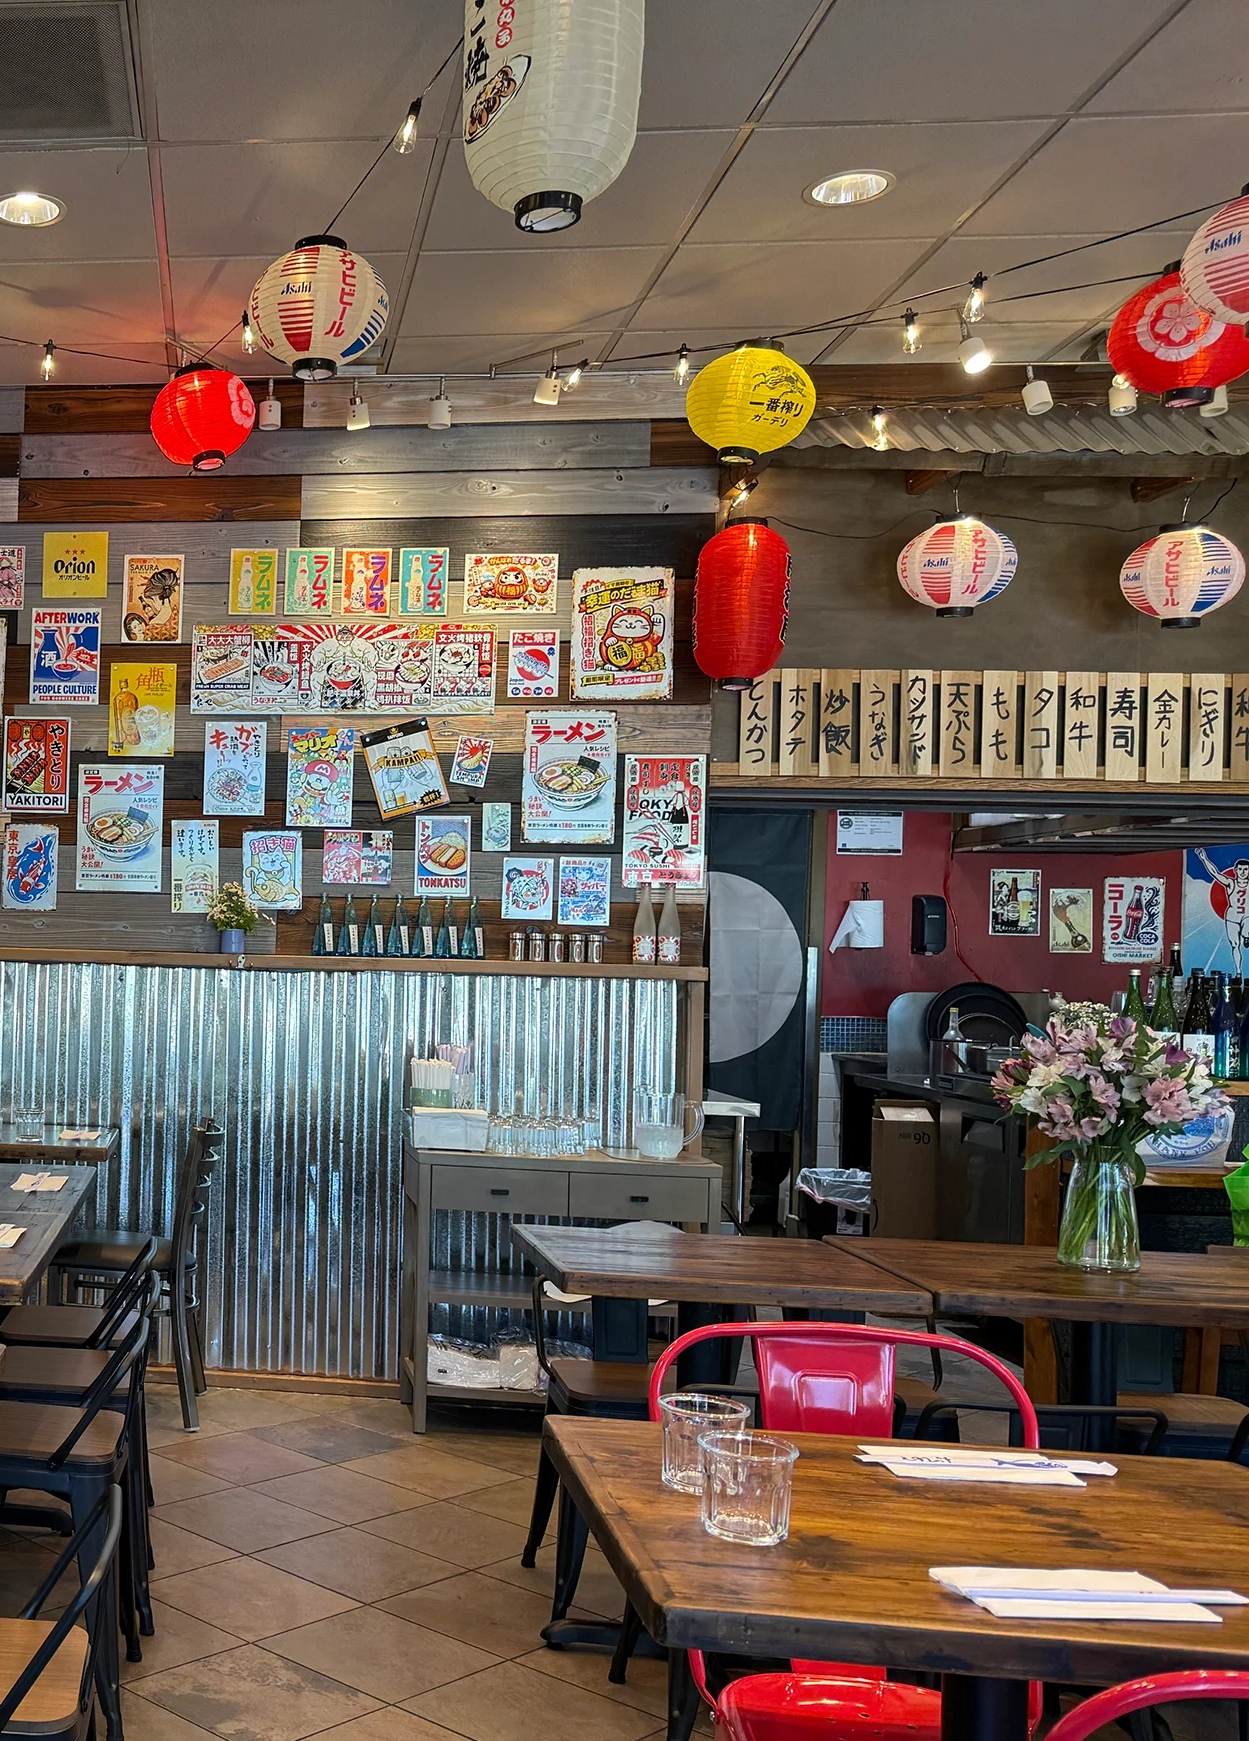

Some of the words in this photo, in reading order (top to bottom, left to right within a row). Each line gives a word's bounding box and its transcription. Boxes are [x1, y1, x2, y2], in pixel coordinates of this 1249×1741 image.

[1205, 230, 1242, 254] Asahi
[280, 281, 312, 295] Asahi
[749, 398, 804, 418] 一番搾り
[54, 557, 95, 574] Orion
[923, 557, 949, 568] Asahi
[961, 529, 987, 595] アサヒビール
[1163, 541, 1184, 606] アサヒビール
[1206, 565, 1231, 577] Asahi
[255, 555, 273, 610] ラムネ
[311, 555, 329, 609] ラムネ
[368, 555, 386, 610] ラムネ
[426, 555, 444, 609] ラムネ
[1124, 572, 1141, 582] Asahi
[513, 633, 554, 643] たこ焼き
[41, 651, 57, 668] 酒
[612, 644, 628, 660] 福
[33, 685, 62, 694] PEOPLE
[63, 685, 97, 694] CULTURE
[745, 681, 768, 764] とんかつ
[786, 685, 808, 756] ホタテ
[822, 689, 851, 756] 炒飯
[869, 684, 888, 761] うなぎ
[945, 683, 971, 765] 天ぷら
[989, 687, 1011, 761] もも
[1032, 688, 1055, 749] タコ
[1068, 687, 1097, 752] 和牛
[1109, 687, 1139, 757] 寿司
[1152, 689, 1179, 769] 金カレー
[1198, 687, 1219, 767] にぎり
[291, 731, 321, 742] スーパー
[293, 735, 337, 752] マリオ
[337, 731, 354, 746] くん
[531, 721, 606, 744] ラーメン
[48, 724, 66, 791] やきとり
[253, 734, 261, 758] やきとり
[84, 772, 154, 795] ラーメン
[456, 775, 480, 783] SHIMP
[9, 796, 63, 806] YAKITORI
[207, 829, 215, 851] おいしい
[252, 838, 296, 854] 招き猫
[173, 878, 183, 911] 一番搾り
[419, 877, 467, 888] TONKATSU
[1236, 889, 1247, 914] グリコ
